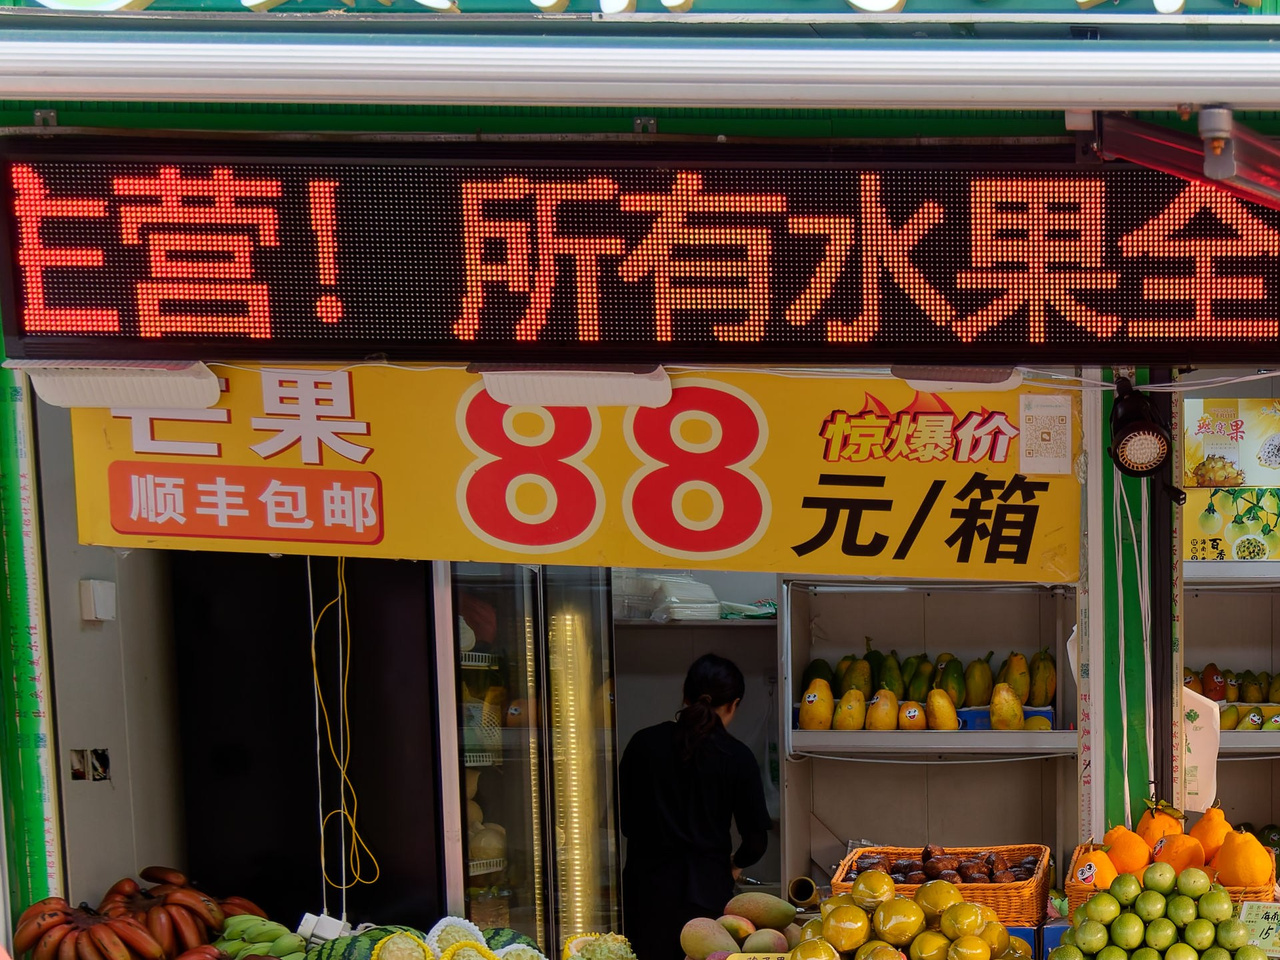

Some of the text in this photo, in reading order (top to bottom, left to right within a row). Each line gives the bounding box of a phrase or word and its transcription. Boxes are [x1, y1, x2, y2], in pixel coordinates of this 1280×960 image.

[820, 408, 1020, 464] 惊爆价
[1193, 415, 1246, 442] 燕窝果
[456, 377, 772, 560] 88
[130, 474, 377, 534] 顺丰包邮
[792, 472, 1049, 565] 元/箱
[1259, 925, 1274, 940] 15
